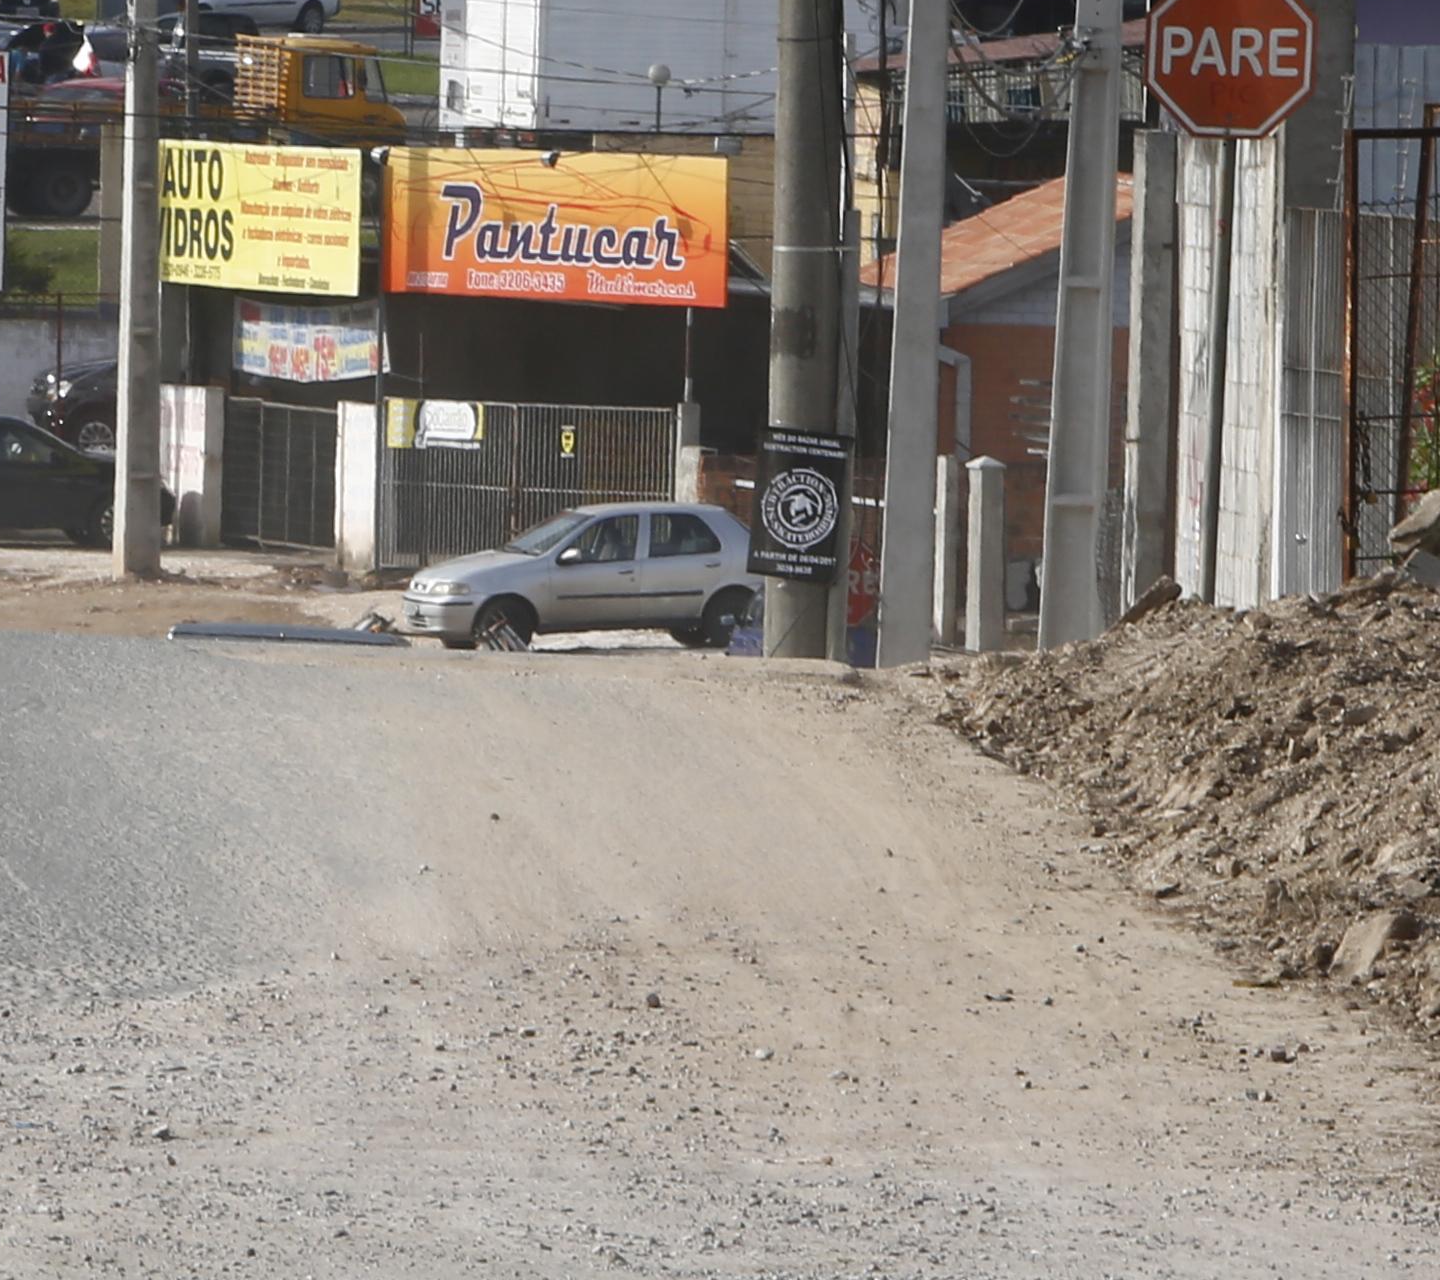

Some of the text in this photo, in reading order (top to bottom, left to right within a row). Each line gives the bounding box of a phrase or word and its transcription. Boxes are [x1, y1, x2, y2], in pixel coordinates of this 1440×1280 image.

[1162, 26, 1299, 77] PARE
[162, 148, 223, 202] AUTO
[440, 181, 686, 270] Pantucar
[587, 270, 697, 299] Multimarcas
[787, 435, 797, 443] DO
[797, 435, 819, 446] BAZAR
[760, 551, 787, 561] PARTIR
[788, 553, 798, 562] DE
